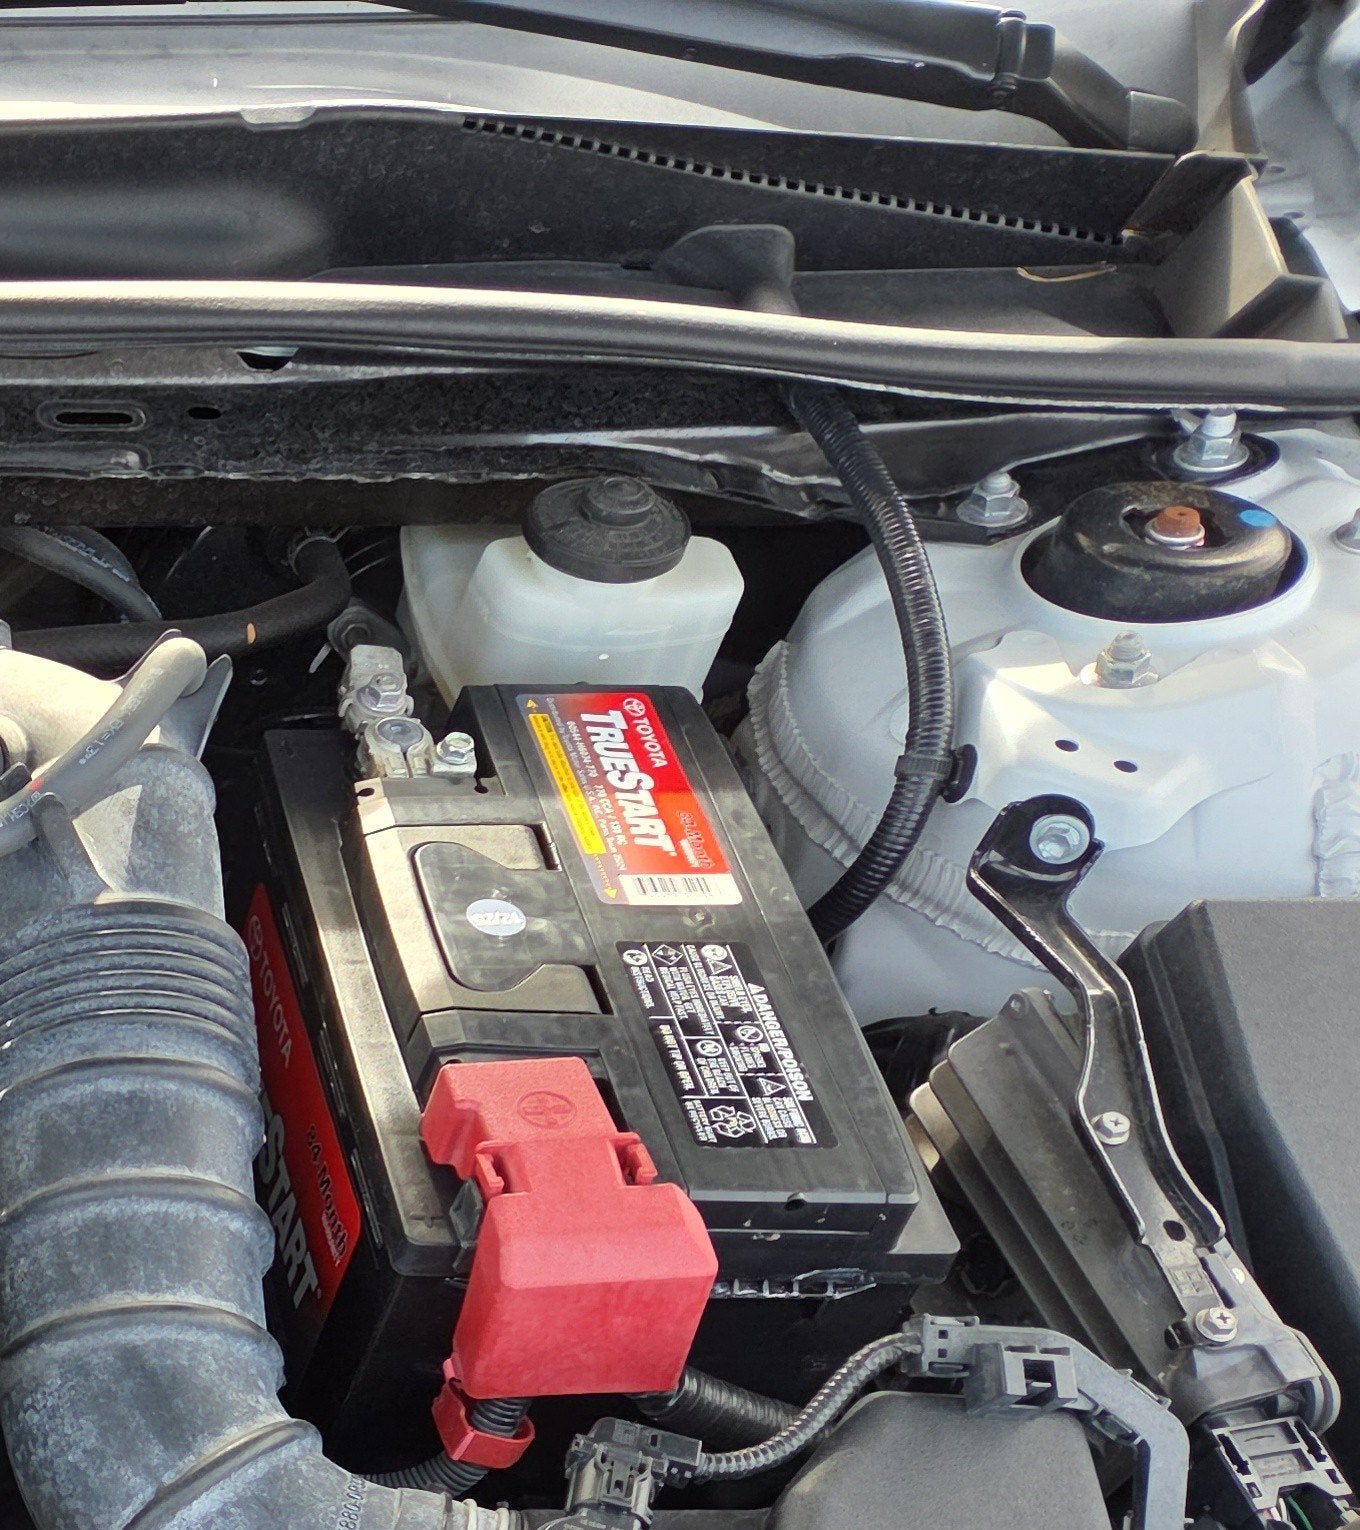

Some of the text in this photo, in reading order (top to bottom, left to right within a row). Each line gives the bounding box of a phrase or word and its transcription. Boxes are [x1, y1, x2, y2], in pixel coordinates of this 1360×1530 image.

[631, 717, 669, 767] TOYOTA
[258, 961, 294, 1070] TOYOTA
[750, 994, 815, 1100] DANGER/POISON
